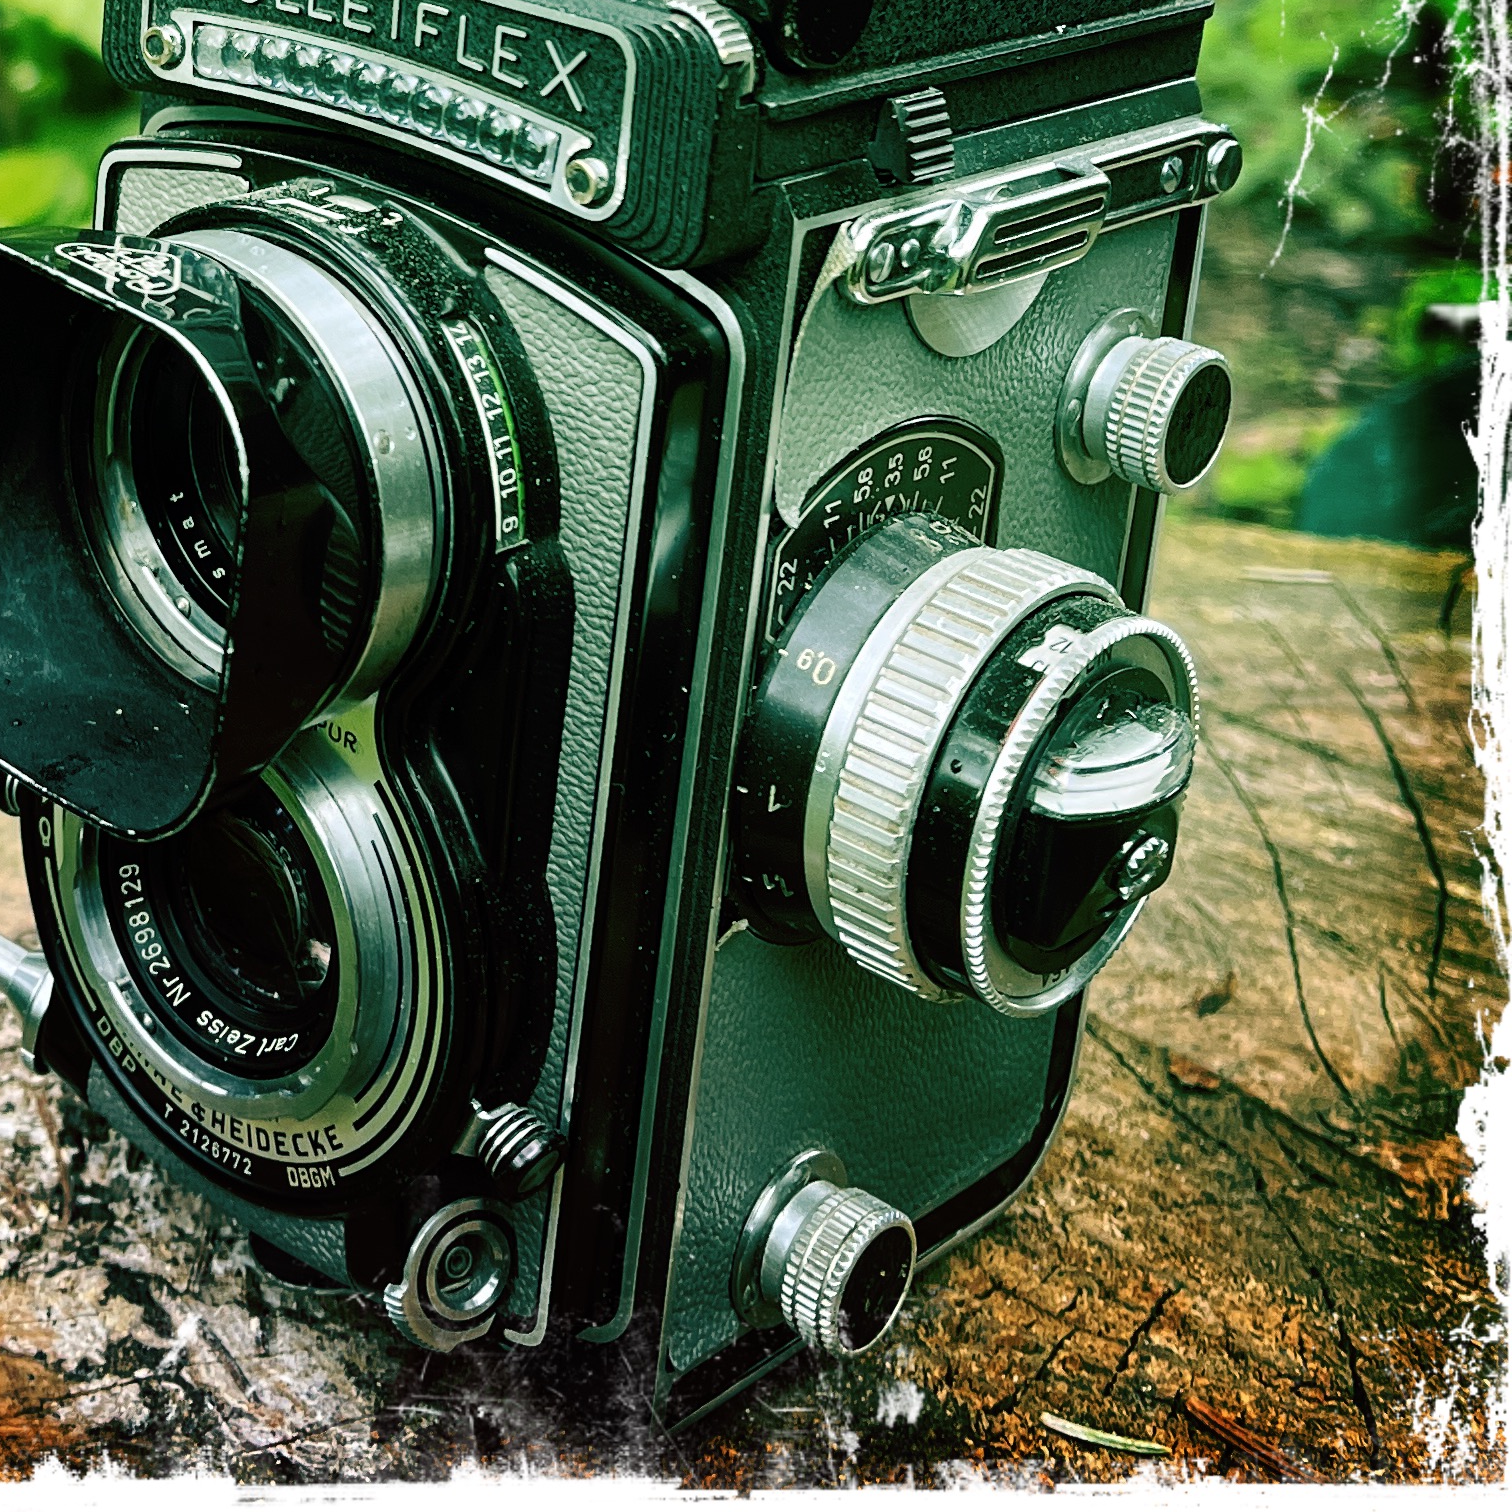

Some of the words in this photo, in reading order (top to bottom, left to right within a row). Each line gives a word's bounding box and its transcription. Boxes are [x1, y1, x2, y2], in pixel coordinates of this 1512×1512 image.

[467, 354, 490, 383] 13
[482, 391, 503, 421] 12
[493, 436, 512, 461] 11
[500, 468, 518, 499] 10
[777, 559, 798, 596] 22
[823, 500, 842, 529] 11
[884, 453, 904, 488] 3.5
[939, 457, 957, 484] 11
[969, 485, 987, 519] 22
[96, 1015, 137, 1073] DBP
[196, 1010, 256, 1055] Zeiss
[256, 1034, 299, 1057] Carl
[211, 1109, 344, 1158] HEIDECKE
